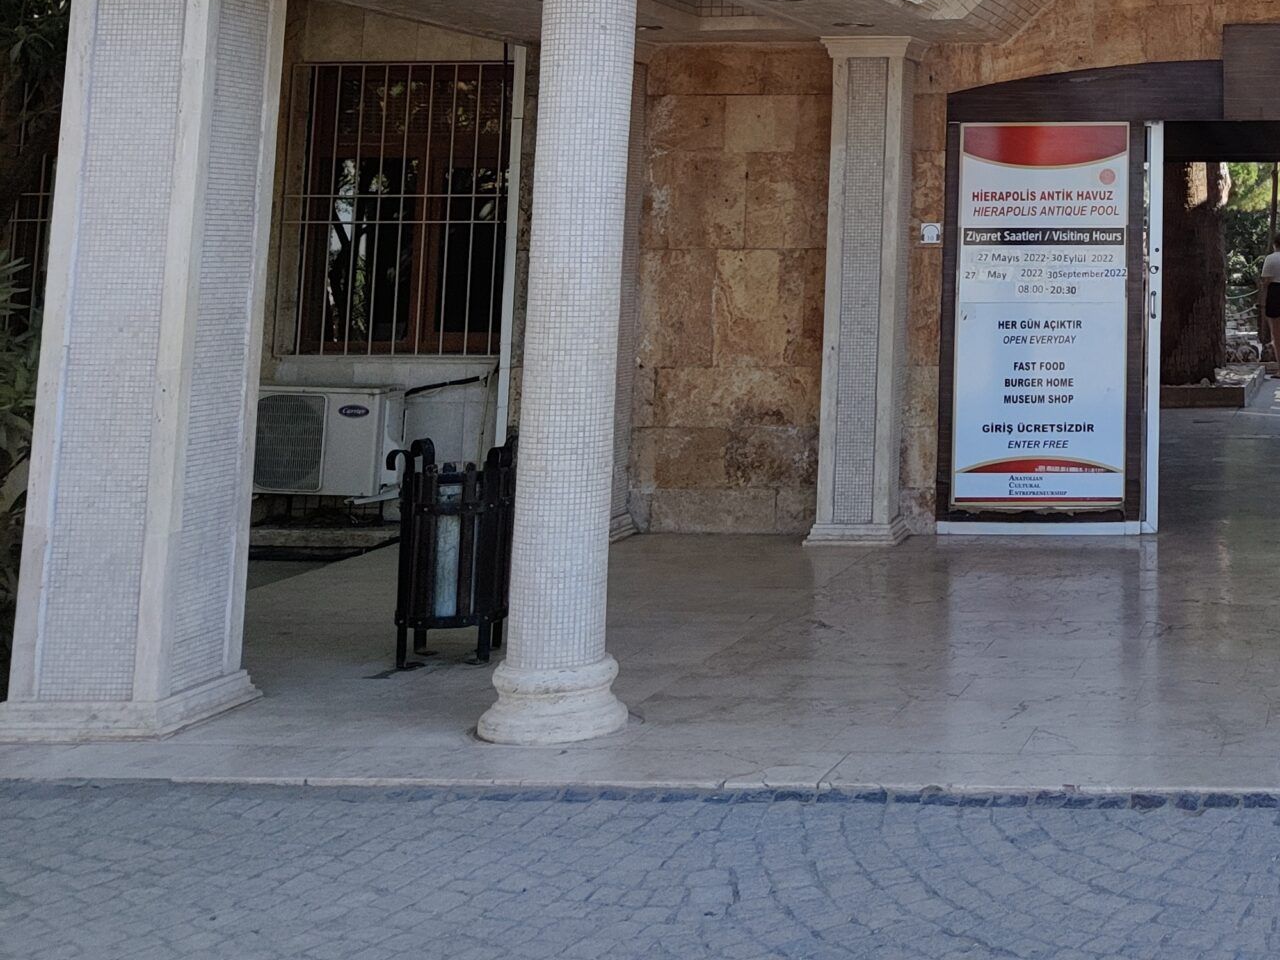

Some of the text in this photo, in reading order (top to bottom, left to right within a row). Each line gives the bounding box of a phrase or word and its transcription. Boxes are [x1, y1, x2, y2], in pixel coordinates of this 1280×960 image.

[972, 189, 1113, 202] HİERAPOLİS ANTİK HAVUZ
[973, 205, 1120, 217] HIERAPOLIS ANTIQUE POOL
[966, 230, 1002, 243] Ziyaret
[1004, 230, 1042, 242] Saatleri
[1052, 230, 1090, 242] Visiting
[1092, 230, 1122, 241] Hours
[977, 253, 989, 262] 27
[991, 253, 1020, 264] Mayıs
[1091, 254, 1114, 263] 2022
[965, 271, 976, 280] 27
[987, 270, 1007, 281] May
[1020, 268, 1043, 278] 2022
[1050, 285, 1077, 295] 20:30
[998, 318, 1082, 331] HER GÜN AÇIKTIR
[1003, 335, 1077, 345] OPEN EVERYDAY
[1013, 361, 1066, 372] FAST FOOD
[1004, 378, 1074, 388] BURGER HOME
[1003, 394, 1074, 404] MUSEUM SHOP
[982, 422, 1095, 435] GİRİŞ ÜCRETSİZDİR
[1007, 440, 1069, 449] ENTER FREE
